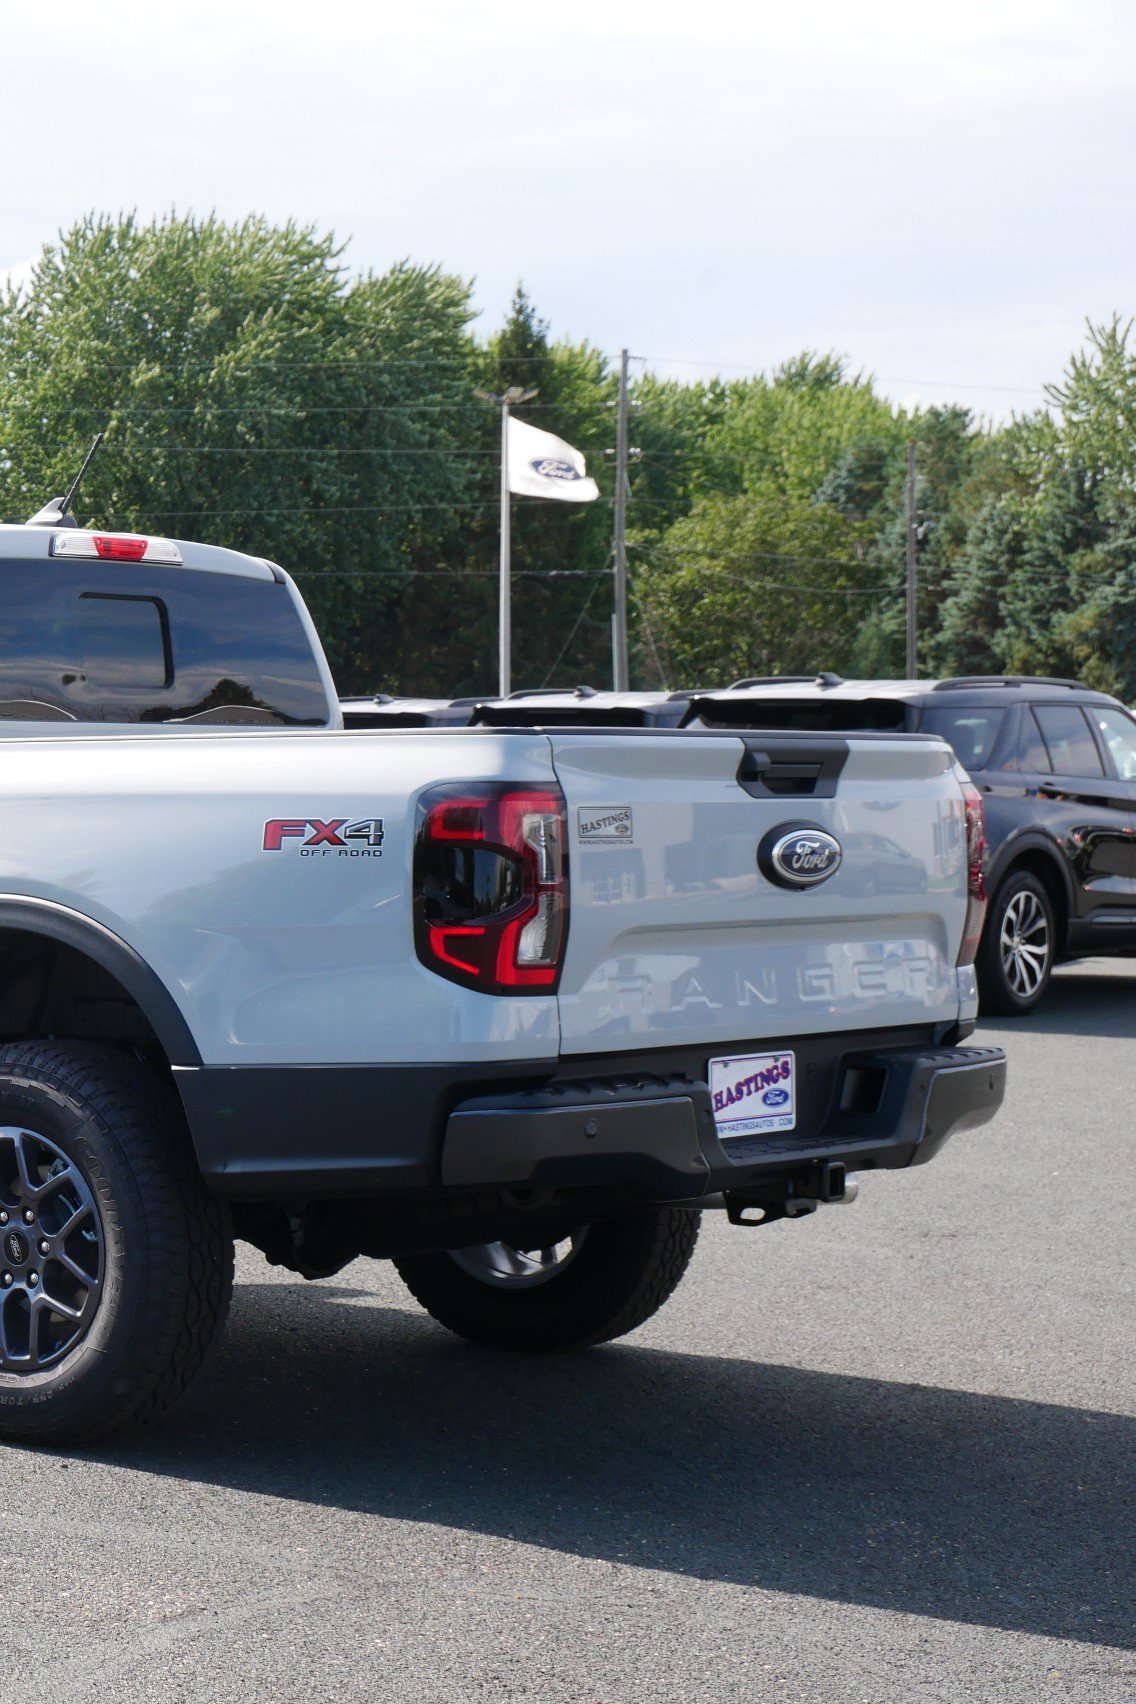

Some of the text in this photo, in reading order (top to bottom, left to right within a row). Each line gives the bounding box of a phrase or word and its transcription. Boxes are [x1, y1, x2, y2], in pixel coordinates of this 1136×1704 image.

[262, 818, 384, 850] FX4
[580, 811, 630, 834] HASTINGS
[300, 849, 383, 857] OFF ROAD
[792, 841, 830, 869] Ford
[608, 956, 937, 1013] RANGER
[712, 1060, 791, 1113] HASTINGS
[765, 1091, 785, 1104] Ford
